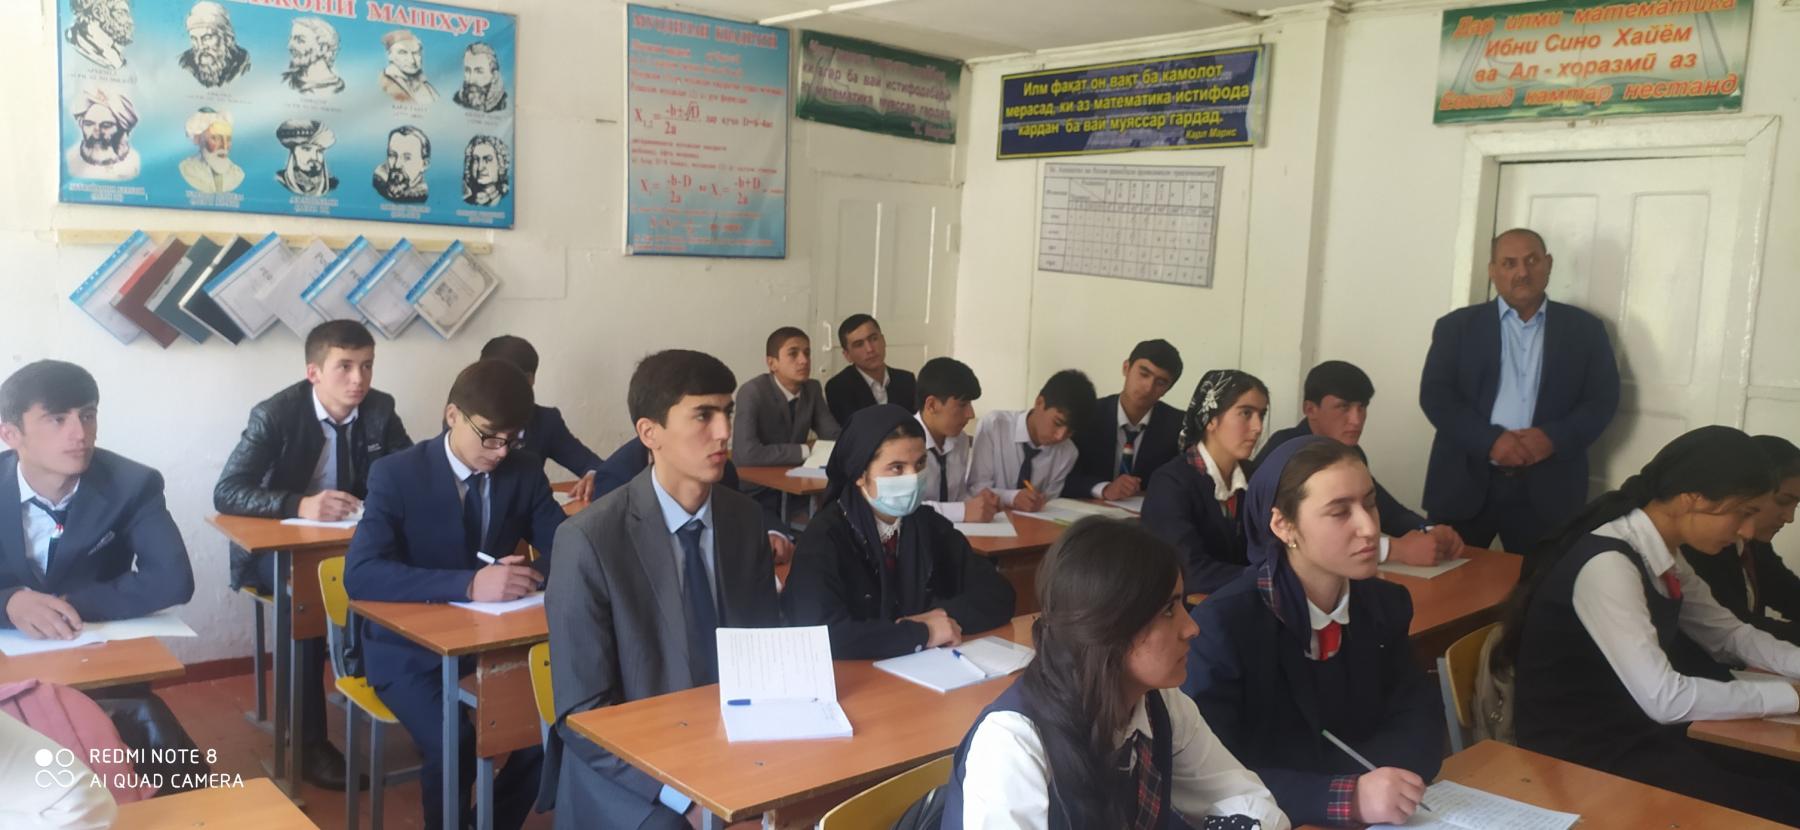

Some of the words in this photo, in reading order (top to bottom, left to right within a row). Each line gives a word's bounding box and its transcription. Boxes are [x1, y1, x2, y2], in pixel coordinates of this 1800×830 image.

[1485, 37, 1538, 58] Ибни
[1545, 33, 1601, 52] Сино
[1612, 24, 1693, 47] Хайём
[1023, 82, 1048, 96] Илм
[1090, 77, 1106, 90] он
[1142, 69, 1158, 84] ба
[1162, 64, 1224, 82] камолот
[1474, 67, 1498, 83] ва
[1509, 61, 1539, 80] Ал
[1669, 53, 1697, 70] аз
[1094, 92, 1172, 110] математика
[1175, 84, 1249, 104] истифода
[1623, 73, 1738, 100] нестанд
[1018, 122, 1059, 138] кардан
[1065, 118, 1080, 133] ба
